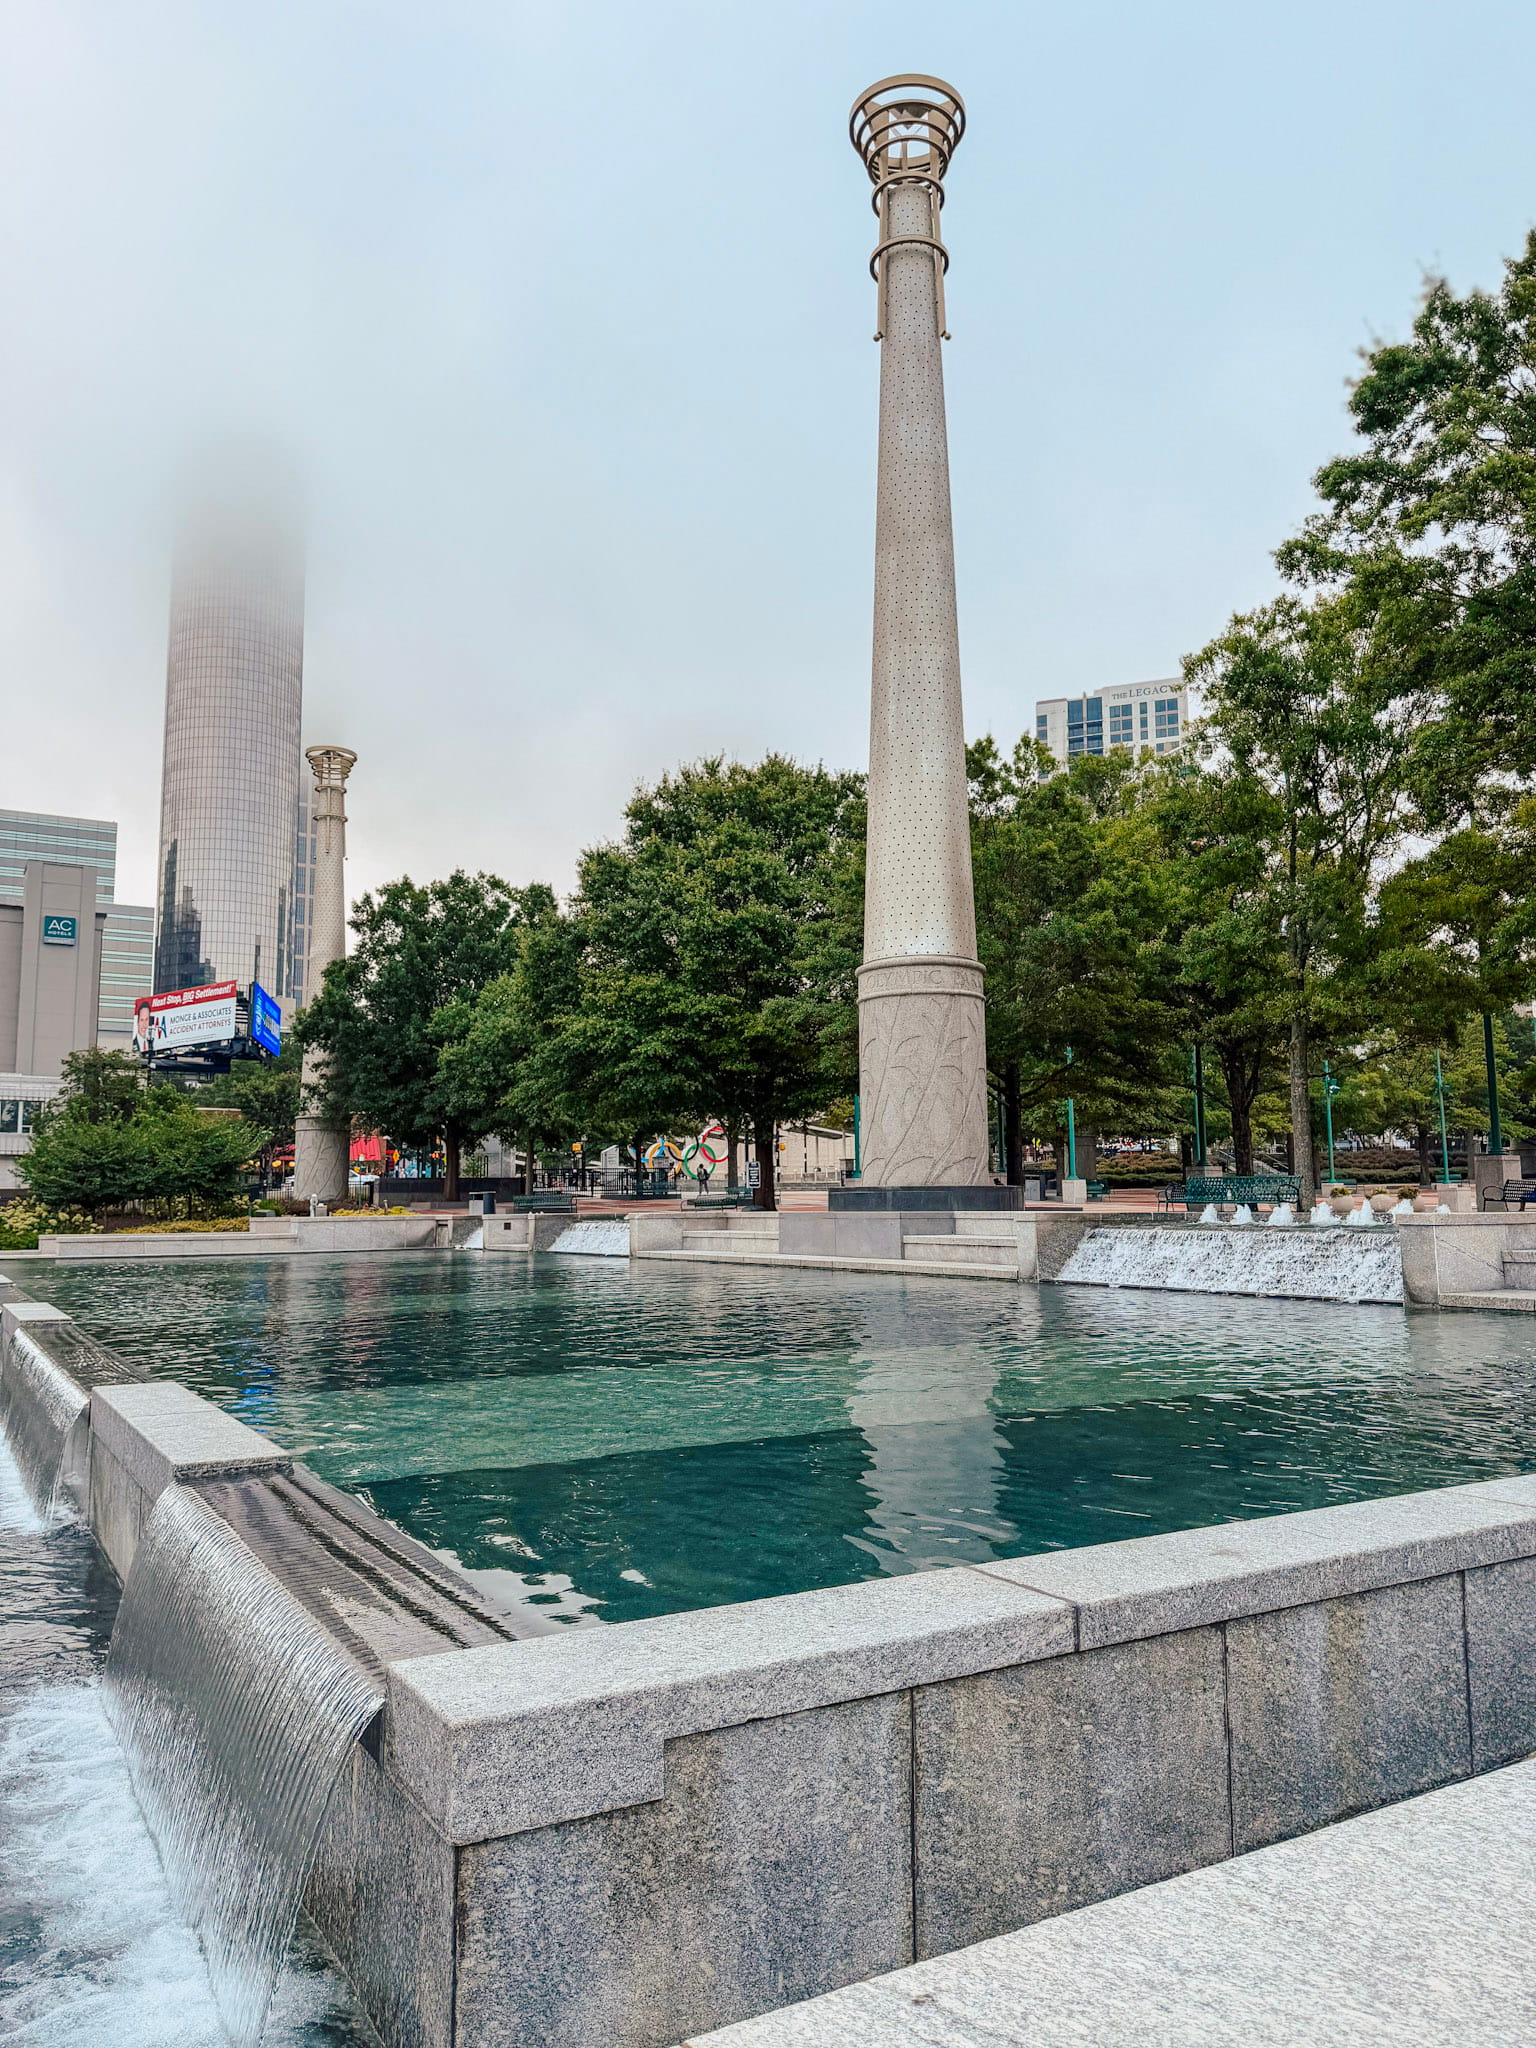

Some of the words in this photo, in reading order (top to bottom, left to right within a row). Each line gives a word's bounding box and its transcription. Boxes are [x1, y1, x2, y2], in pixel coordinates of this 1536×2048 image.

[1112, 692, 1128, 700] THE
[48, 919, 72, 932] AC
[152, 998, 166, 1008] Next
[167, 995, 182, 1005] Stop,
[183, 991, 195, 1001] BIG
[170, 1014, 192, 1025] MONGE
[198, 1007, 232, 1019] ASSOCIATES
[169, 1025, 198, 1035] ACCIDENT
[198, 1019, 231, 1030] ATTORNEYS
